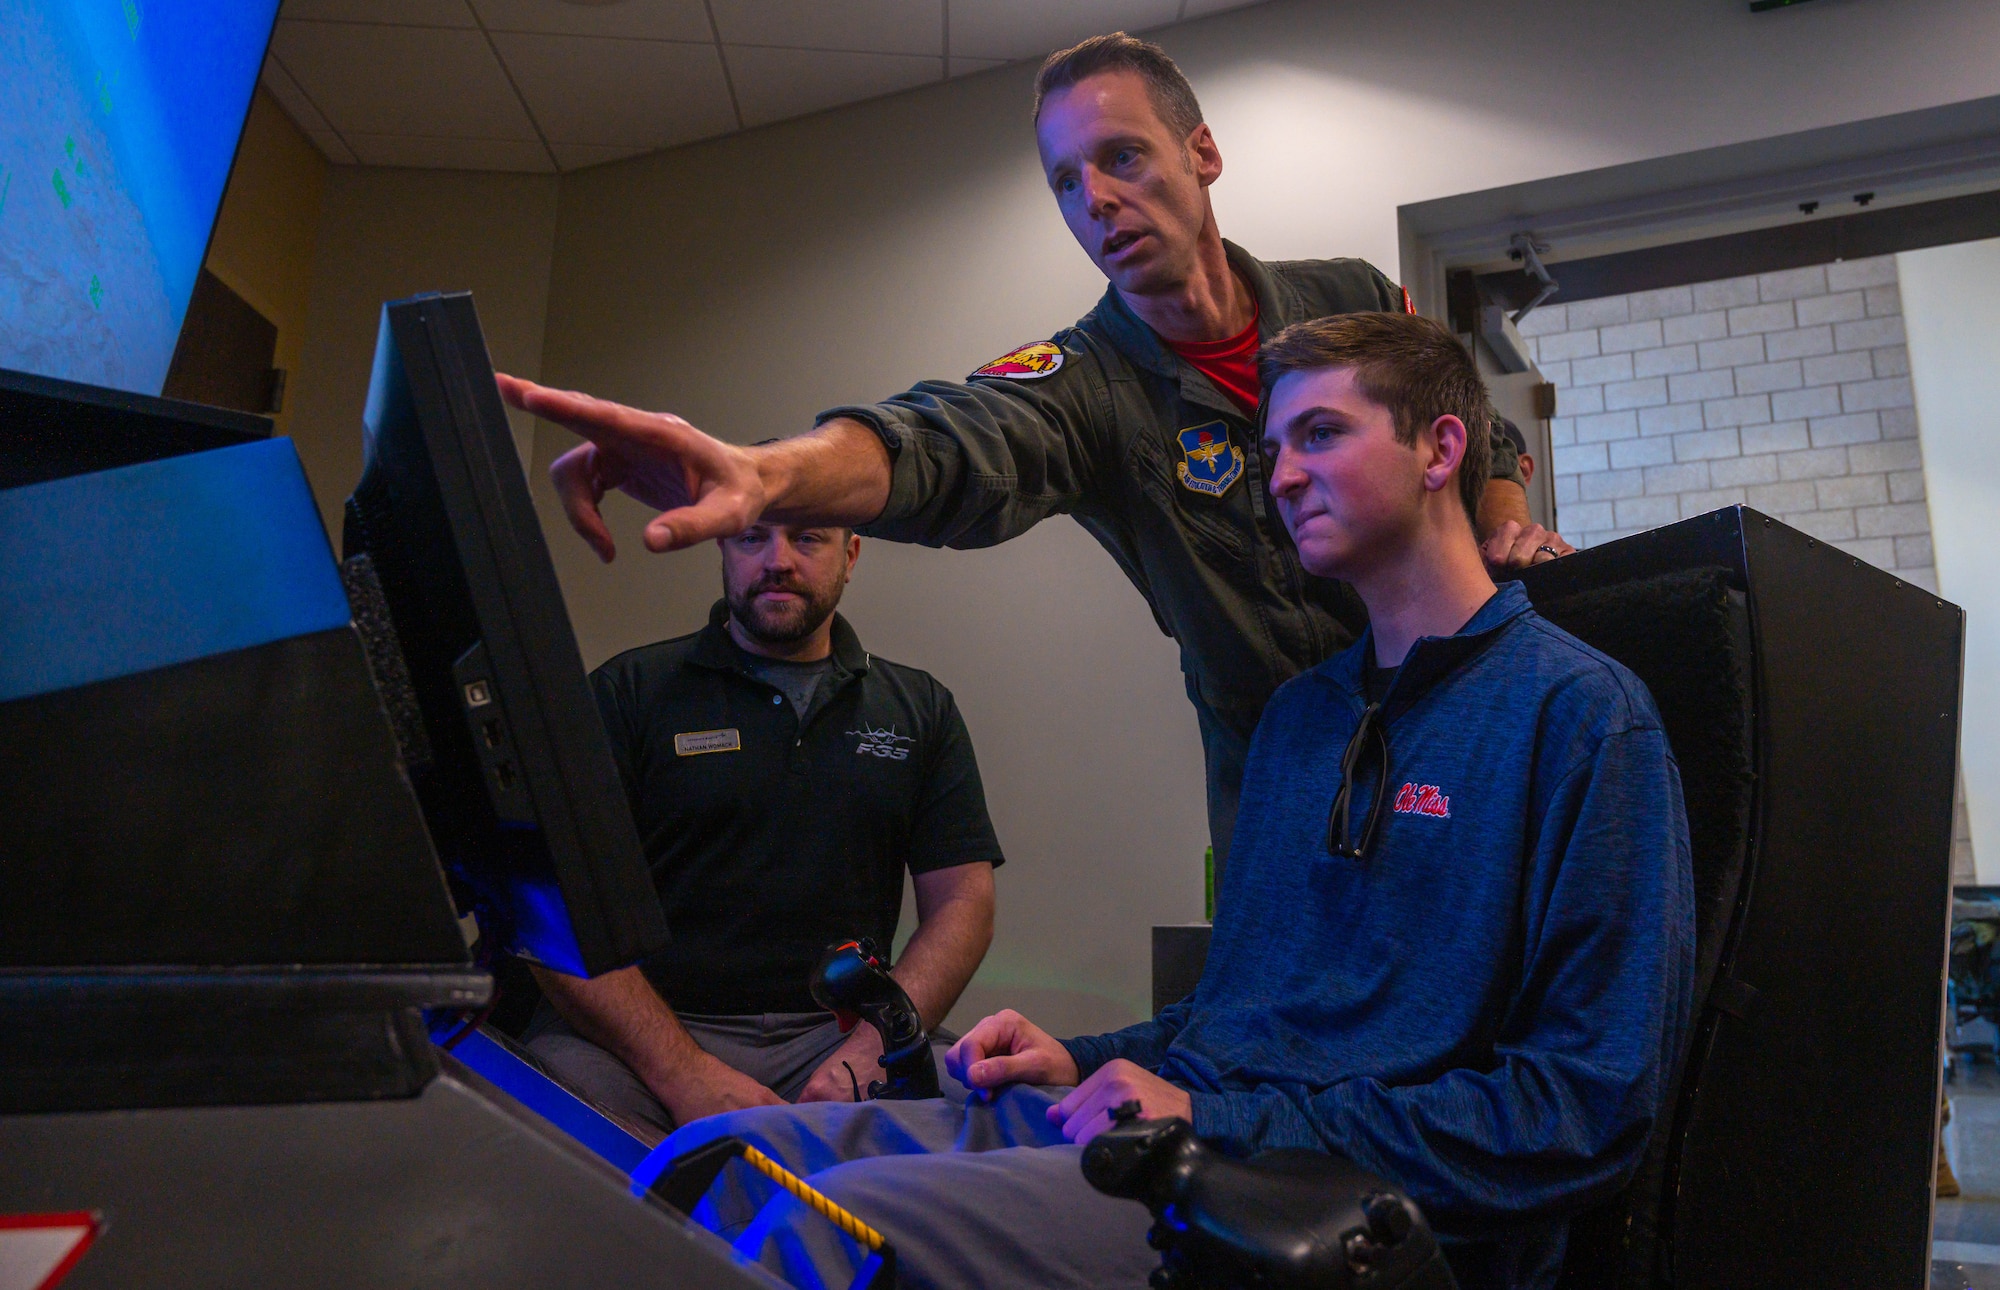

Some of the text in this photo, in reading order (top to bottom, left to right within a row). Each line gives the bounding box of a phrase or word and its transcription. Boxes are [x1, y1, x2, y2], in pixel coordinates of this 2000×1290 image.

[684, 744, 707, 752] NATHAN
[1393, 782, 1450, 818] Ole Miss
